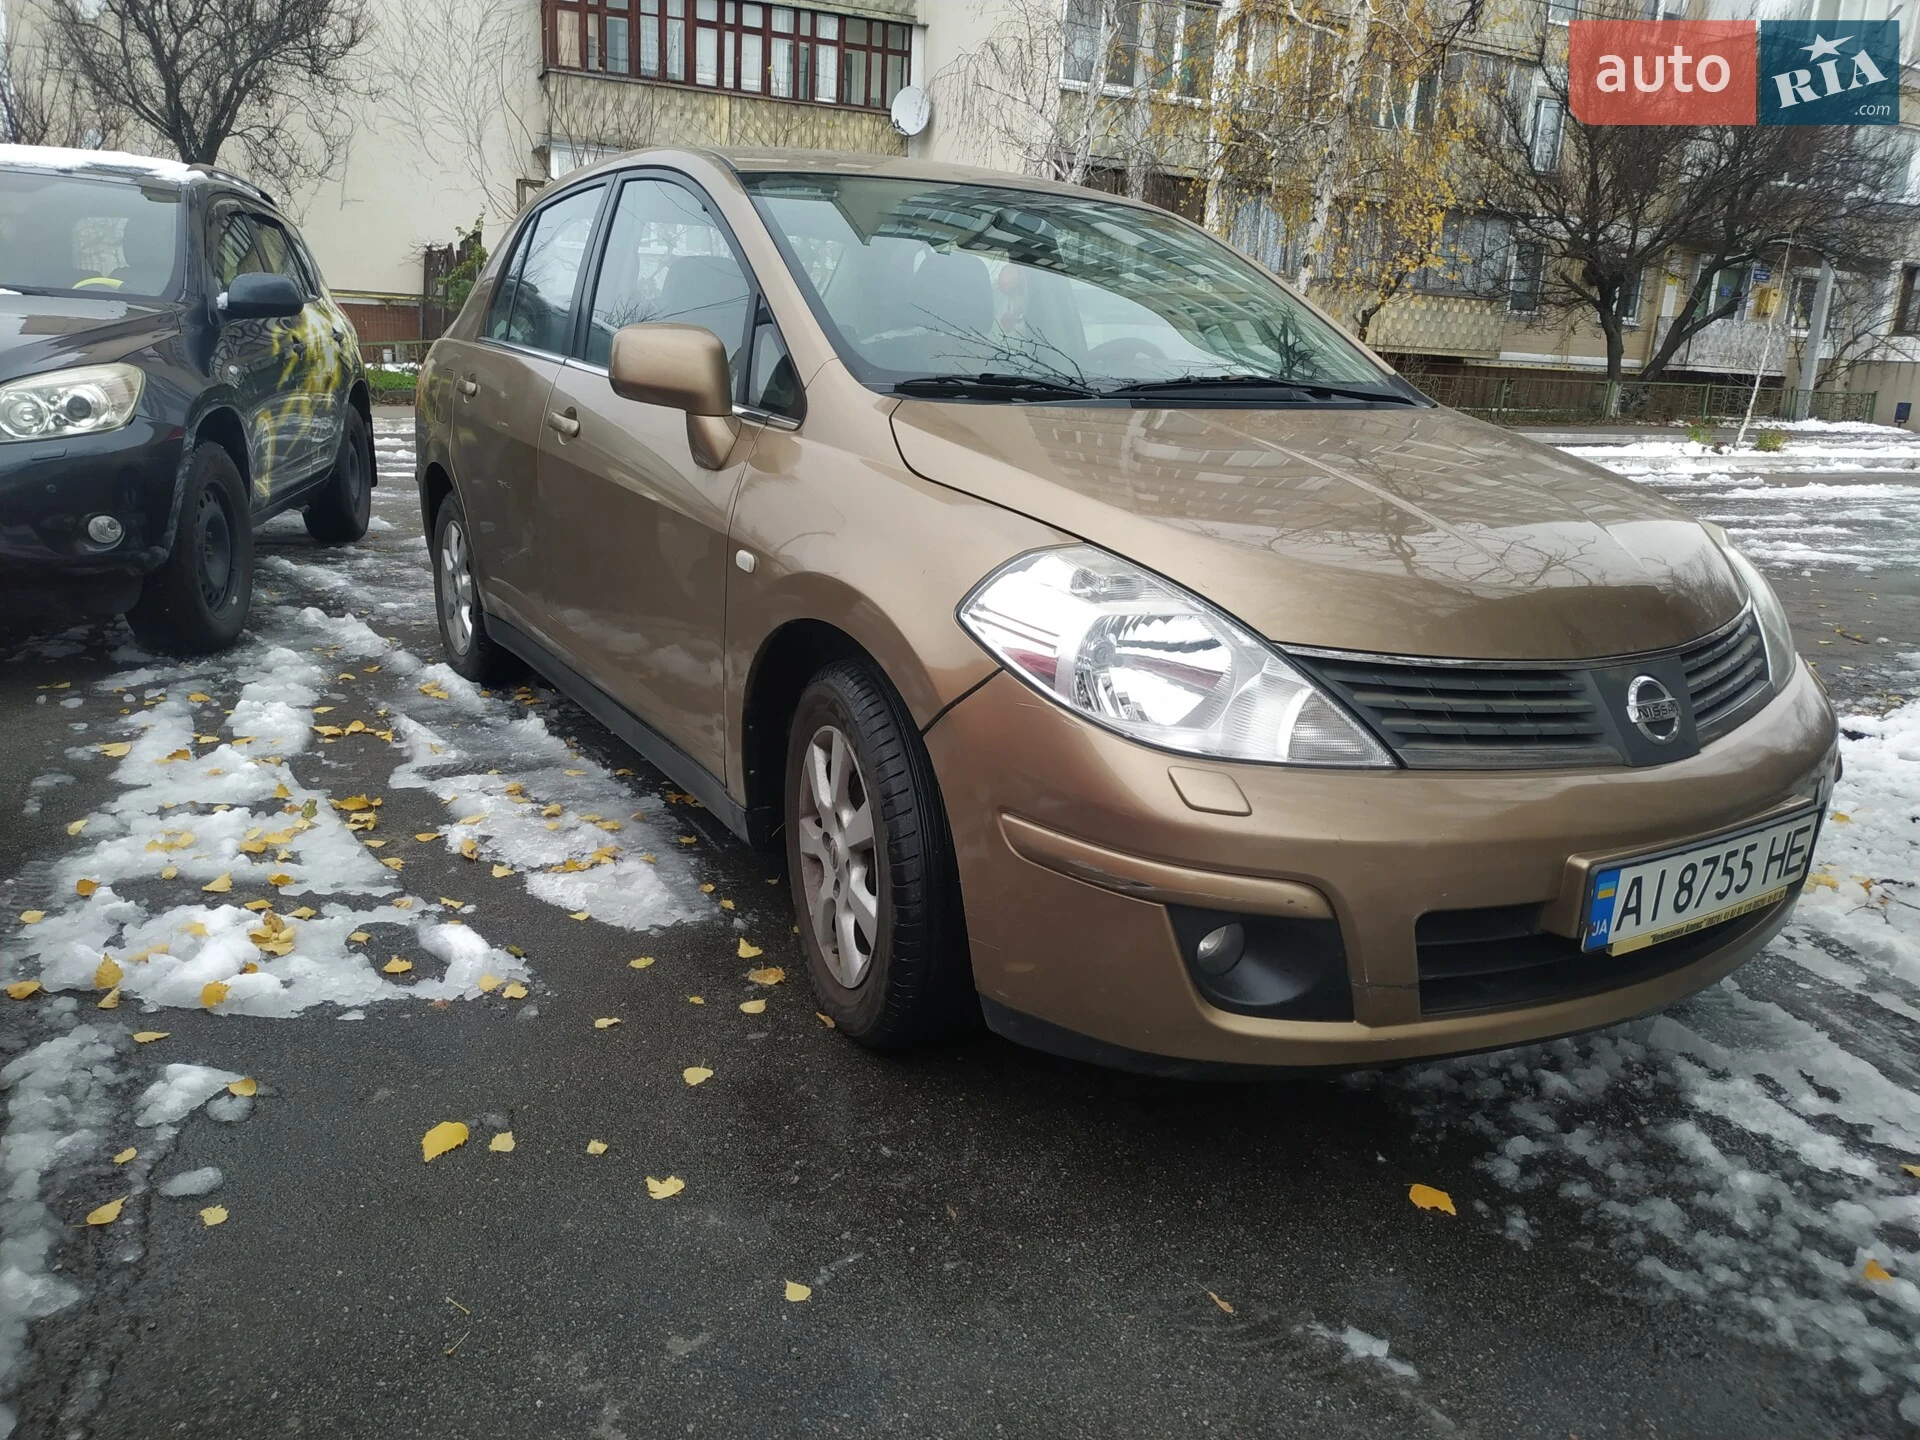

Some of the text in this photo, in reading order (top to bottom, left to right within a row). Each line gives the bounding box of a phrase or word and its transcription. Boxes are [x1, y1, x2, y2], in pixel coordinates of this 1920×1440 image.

[1614, 869, 1667, 932] AI
[1672, 843, 1758, 915] 8755
[1760, 824, 1811, 886] HE
[1591, 918, 1608, 937] UA
